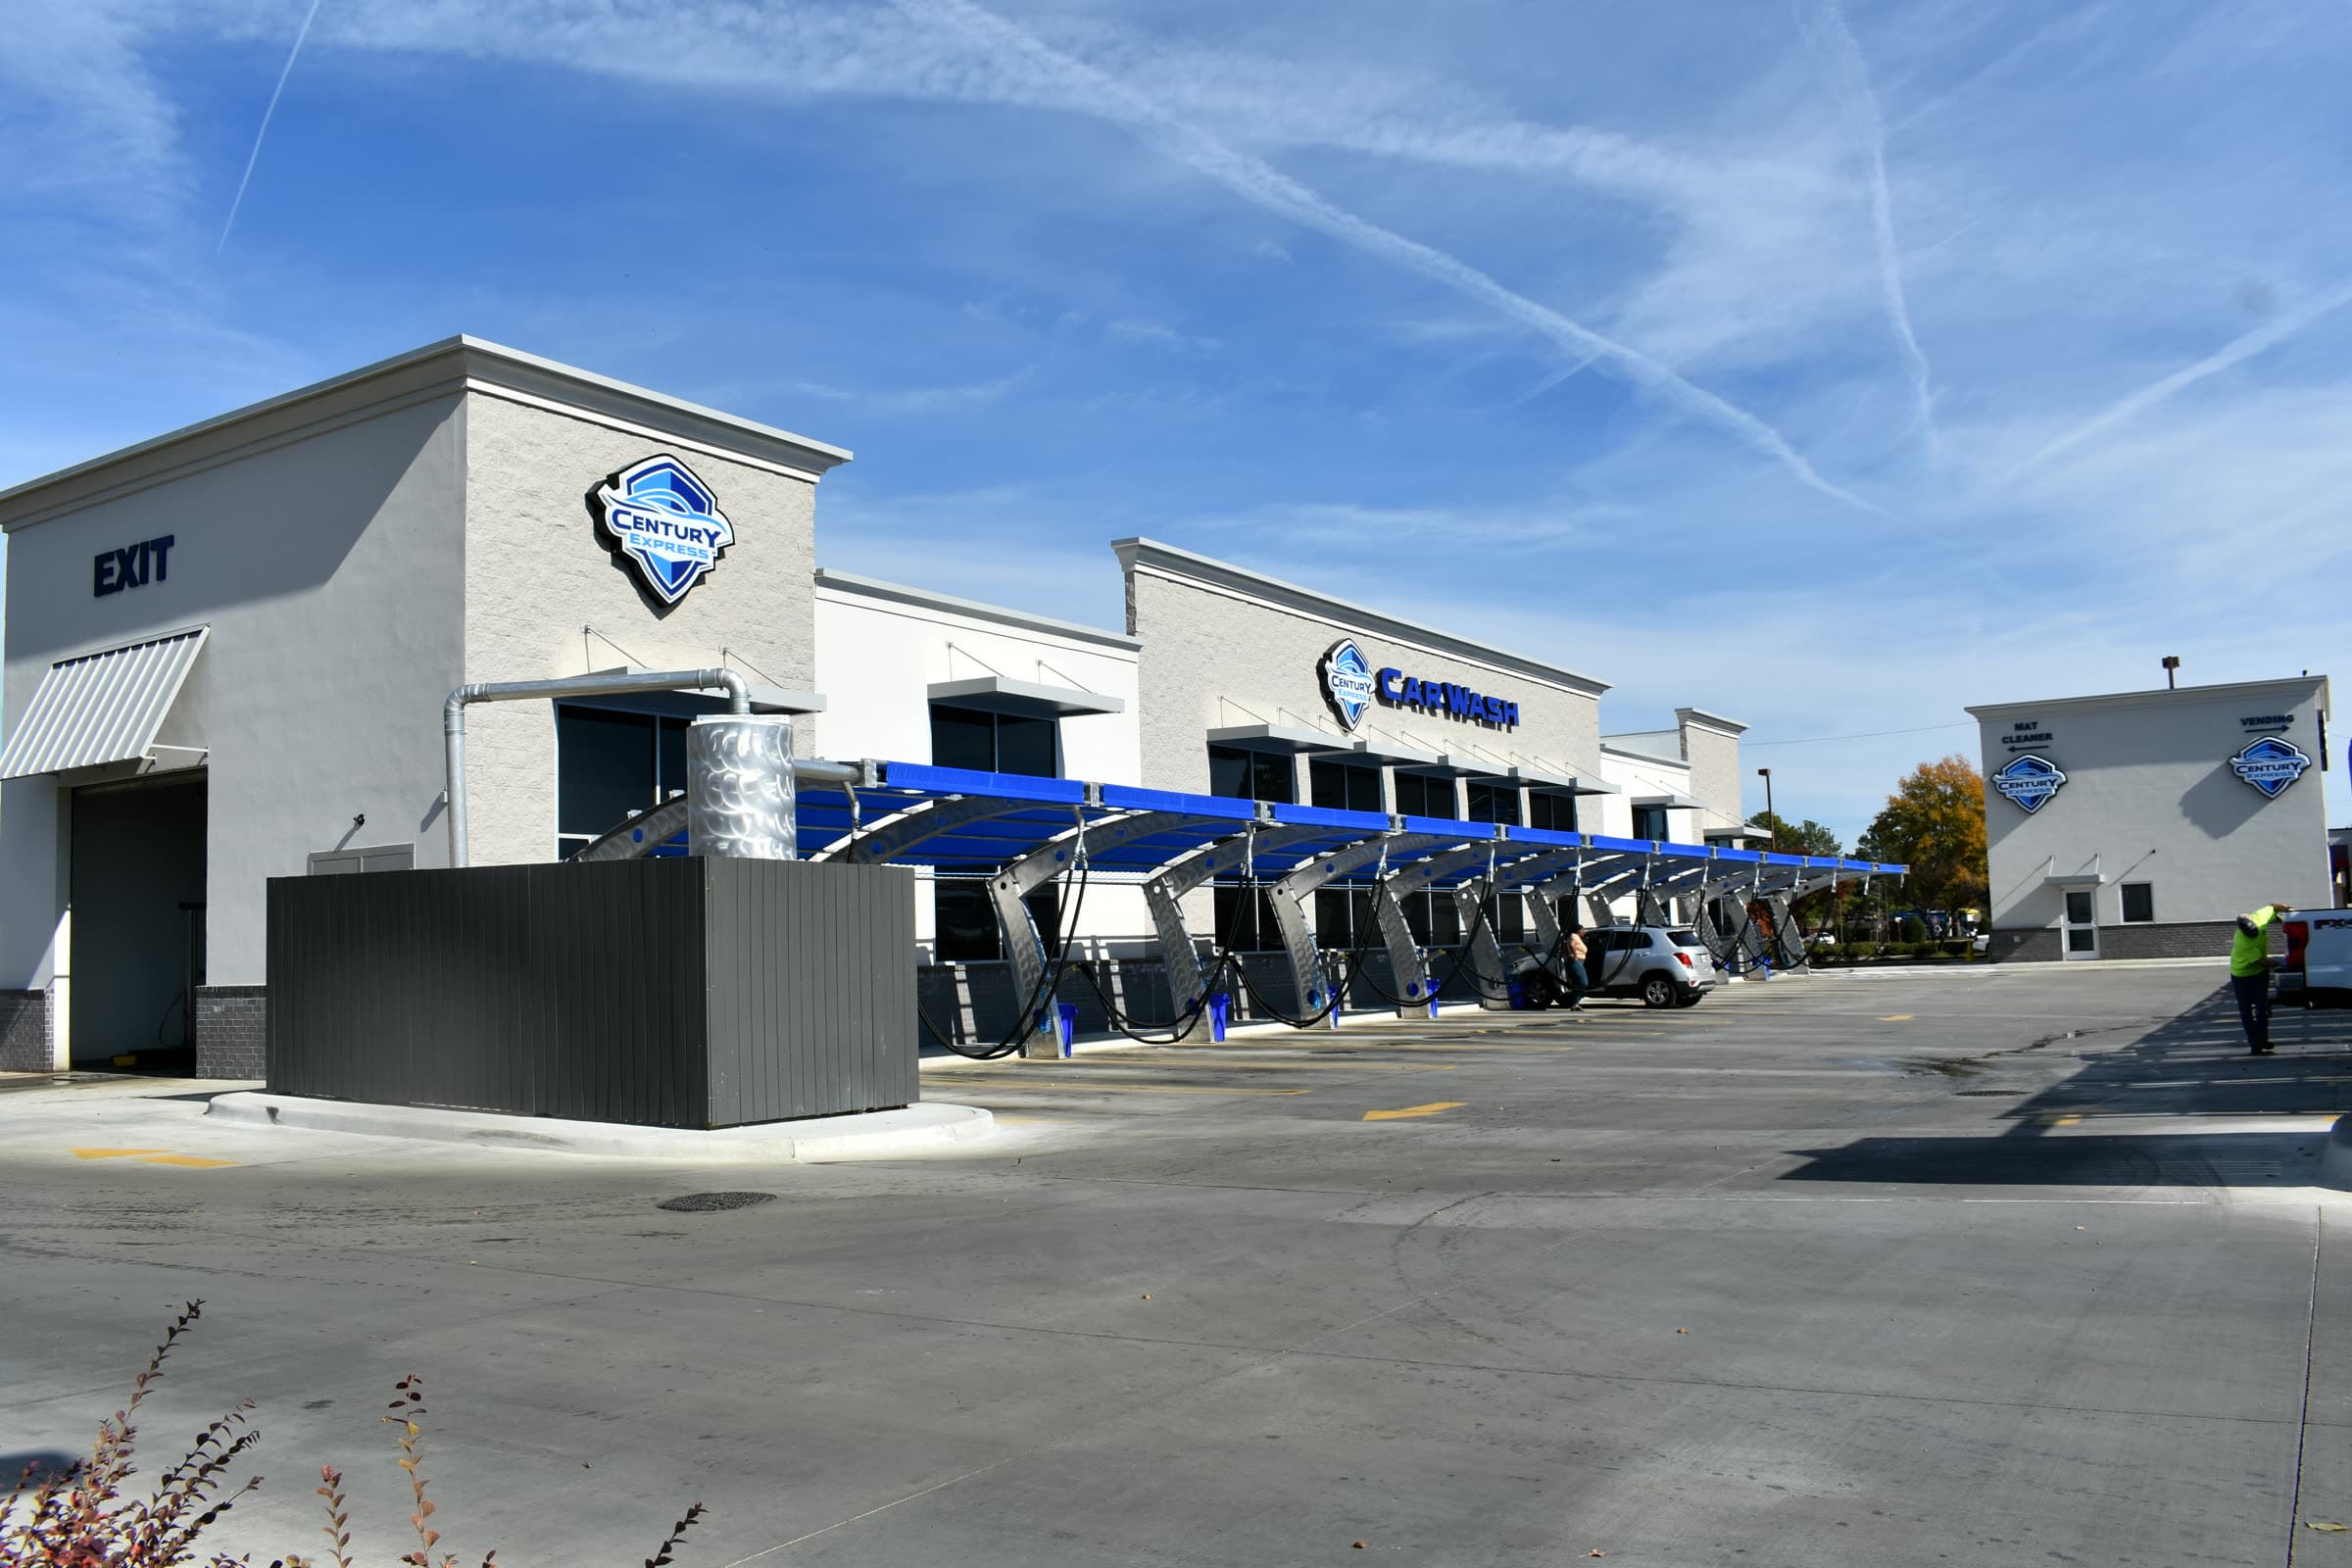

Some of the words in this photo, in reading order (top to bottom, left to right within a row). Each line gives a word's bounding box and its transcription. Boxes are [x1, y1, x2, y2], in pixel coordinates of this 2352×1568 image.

[612, 509, 721, 548] CENTURY
[629, 532, 710, 560] EXPRESS
[94, 534, 174, 597] EXIT
[1331, 674, 1371, 695] CENTURY
[1380, 667, 1445, 710] CAR
[1444, 682, 1520, 727] WASH
[2014, 721, 2038, 731] MAT
[2239, 714, 2295, 726] VENDING
[2002, 732, 2053, 745] CLEANER
[2235, 761, 2302, 774] CENTURY
[1999, 778, 2058, 791] CENTURY
